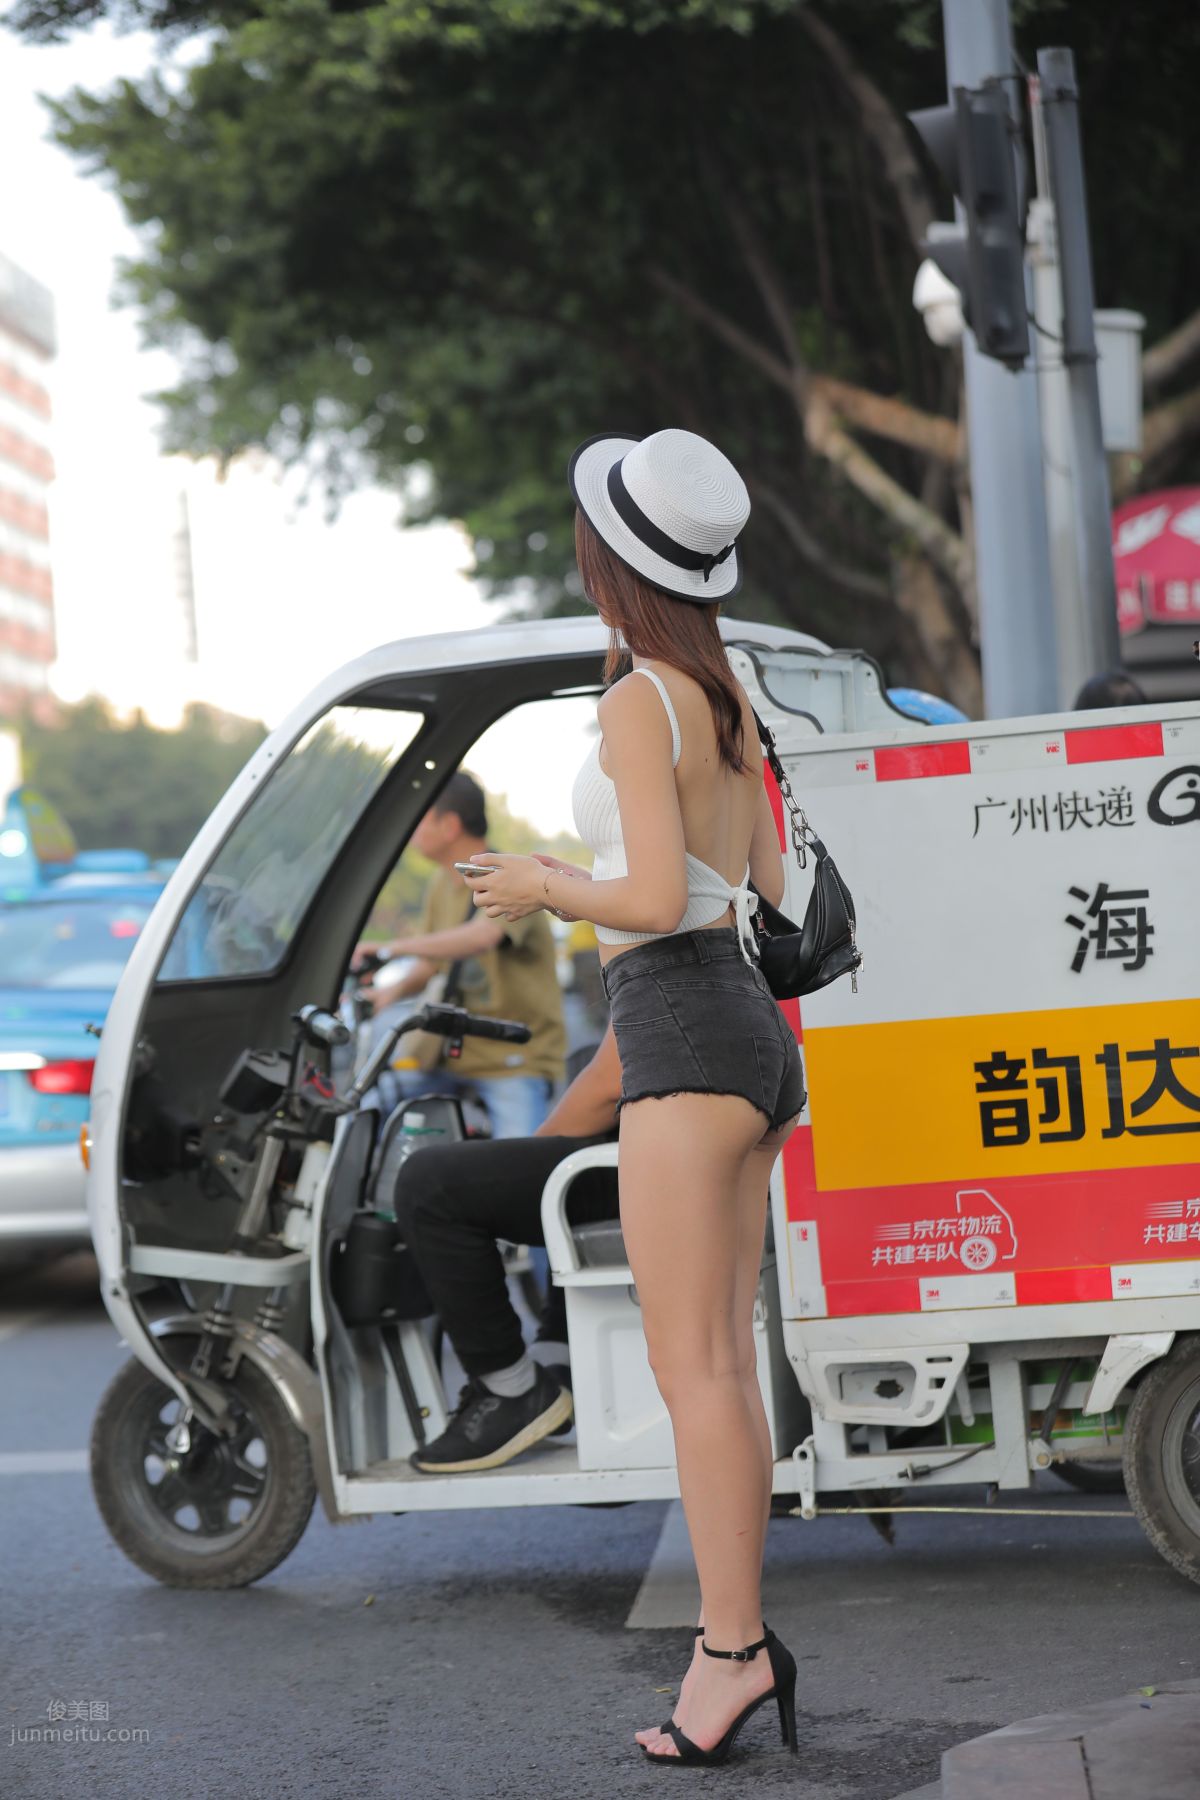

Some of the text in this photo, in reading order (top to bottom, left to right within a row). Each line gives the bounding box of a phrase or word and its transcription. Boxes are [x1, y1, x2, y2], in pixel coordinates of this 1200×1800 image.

[972, 785, 1137, 839] 广州快递
[1065, 882, 1155, 974] 海
[974, 1038, 1200, 1148] 韵达
[872, 1241, 959, 1267] 共建车队
[912, 1215, 1003, 1240] 京东物流
